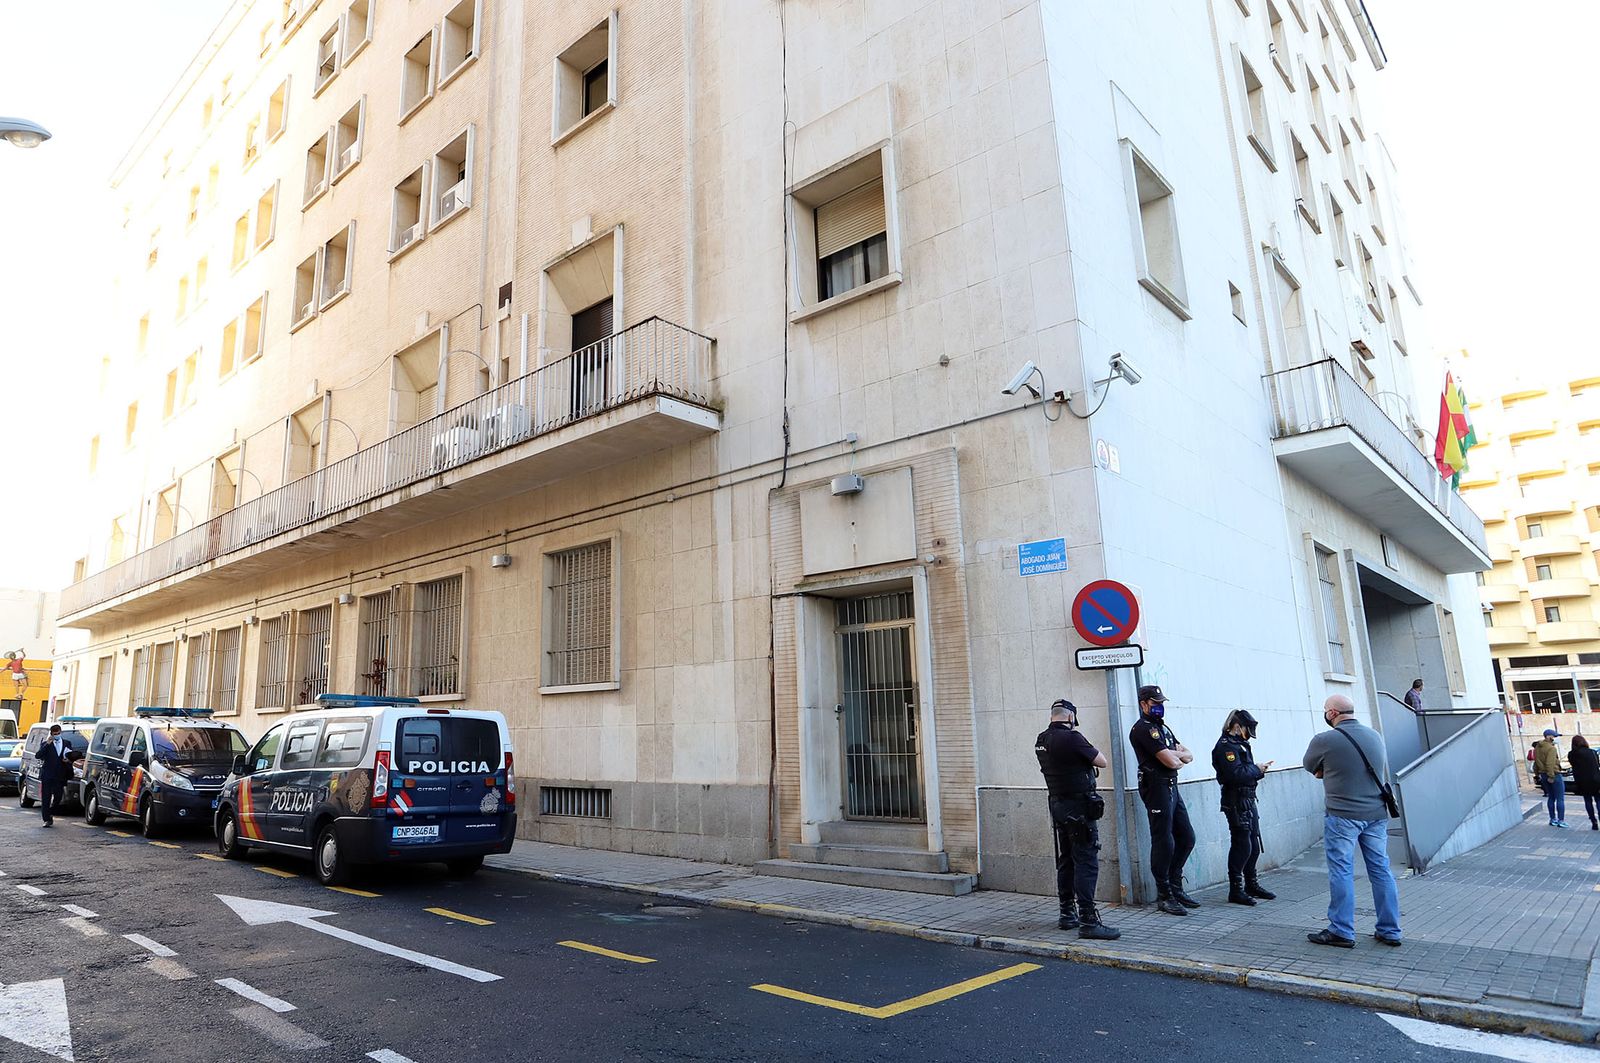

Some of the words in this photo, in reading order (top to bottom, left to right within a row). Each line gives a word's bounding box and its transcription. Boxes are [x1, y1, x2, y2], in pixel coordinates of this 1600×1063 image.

[1021, 555, 1045, 564] ABOGADO
[1046, 553, 1060, 561] JUAN
[408, 761, 490, 773] POLICIA
[97, 771, 121, 788] POLICIA
[270, 792, 314, 812] POLICIA
